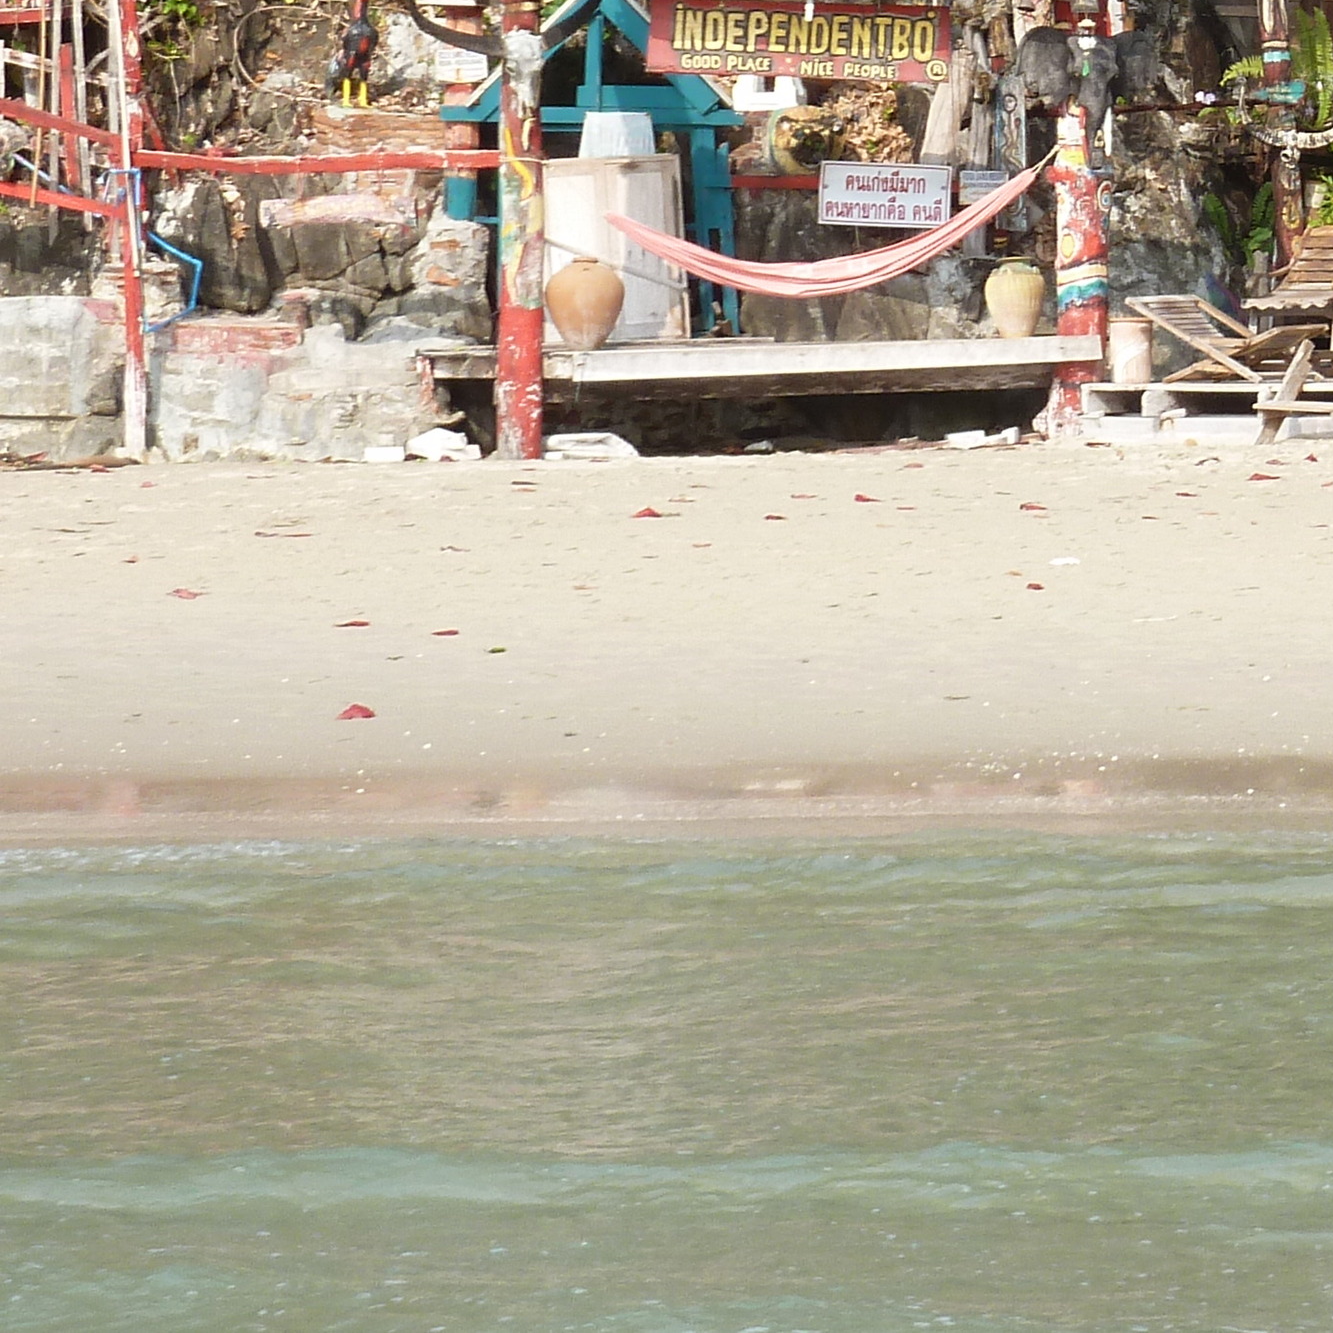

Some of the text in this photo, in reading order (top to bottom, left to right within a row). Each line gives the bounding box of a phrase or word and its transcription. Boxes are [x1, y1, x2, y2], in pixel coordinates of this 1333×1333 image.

[680, 52, 722, 70] GOOD
[726, 53, 772, 72] PLACE
[842, 61, 897, 79] PEOPLE
